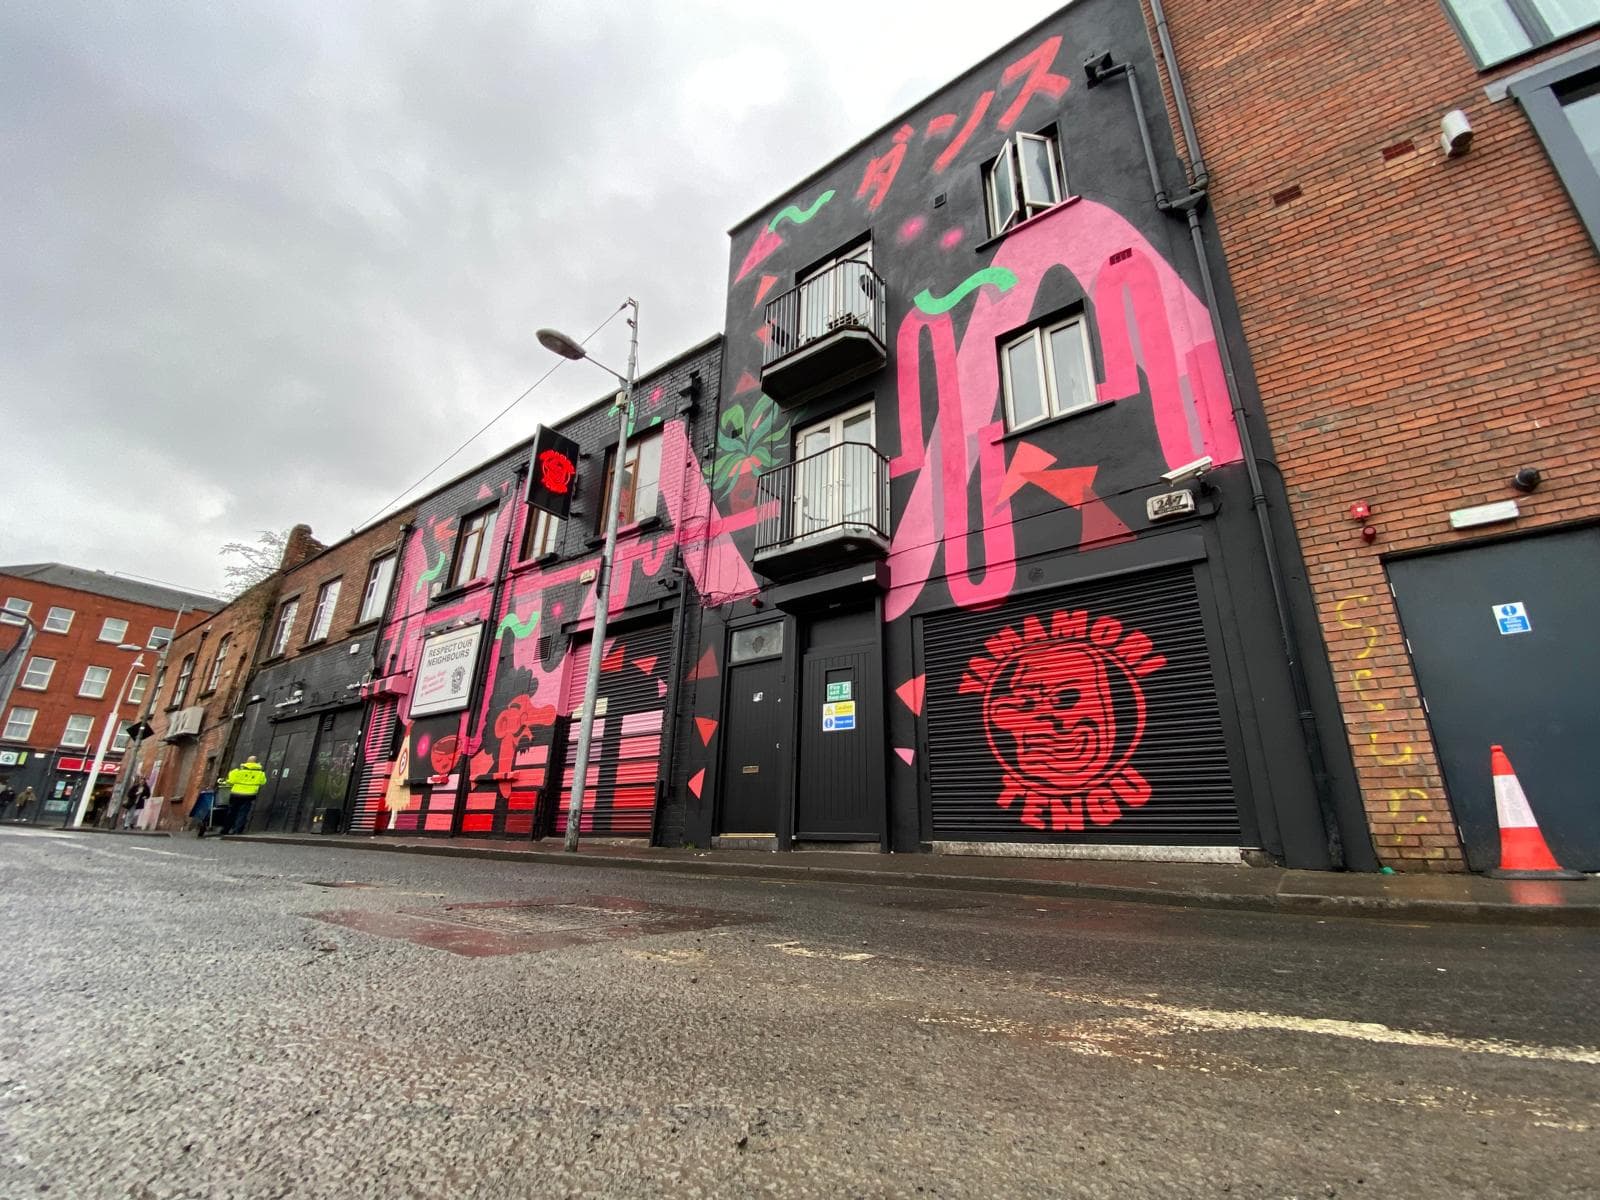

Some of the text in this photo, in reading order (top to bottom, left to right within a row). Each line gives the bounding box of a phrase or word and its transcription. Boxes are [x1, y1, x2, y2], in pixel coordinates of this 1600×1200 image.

[856, 35, 1071, 213] ダンス
[428, 648, 469, 666] NEIGHBOURS
[429, 639, 472, 657] RESPECT OUR
[957, 608, 1169, 694] YAMAMORI
[995, 766, 1153, 832] TENGU
